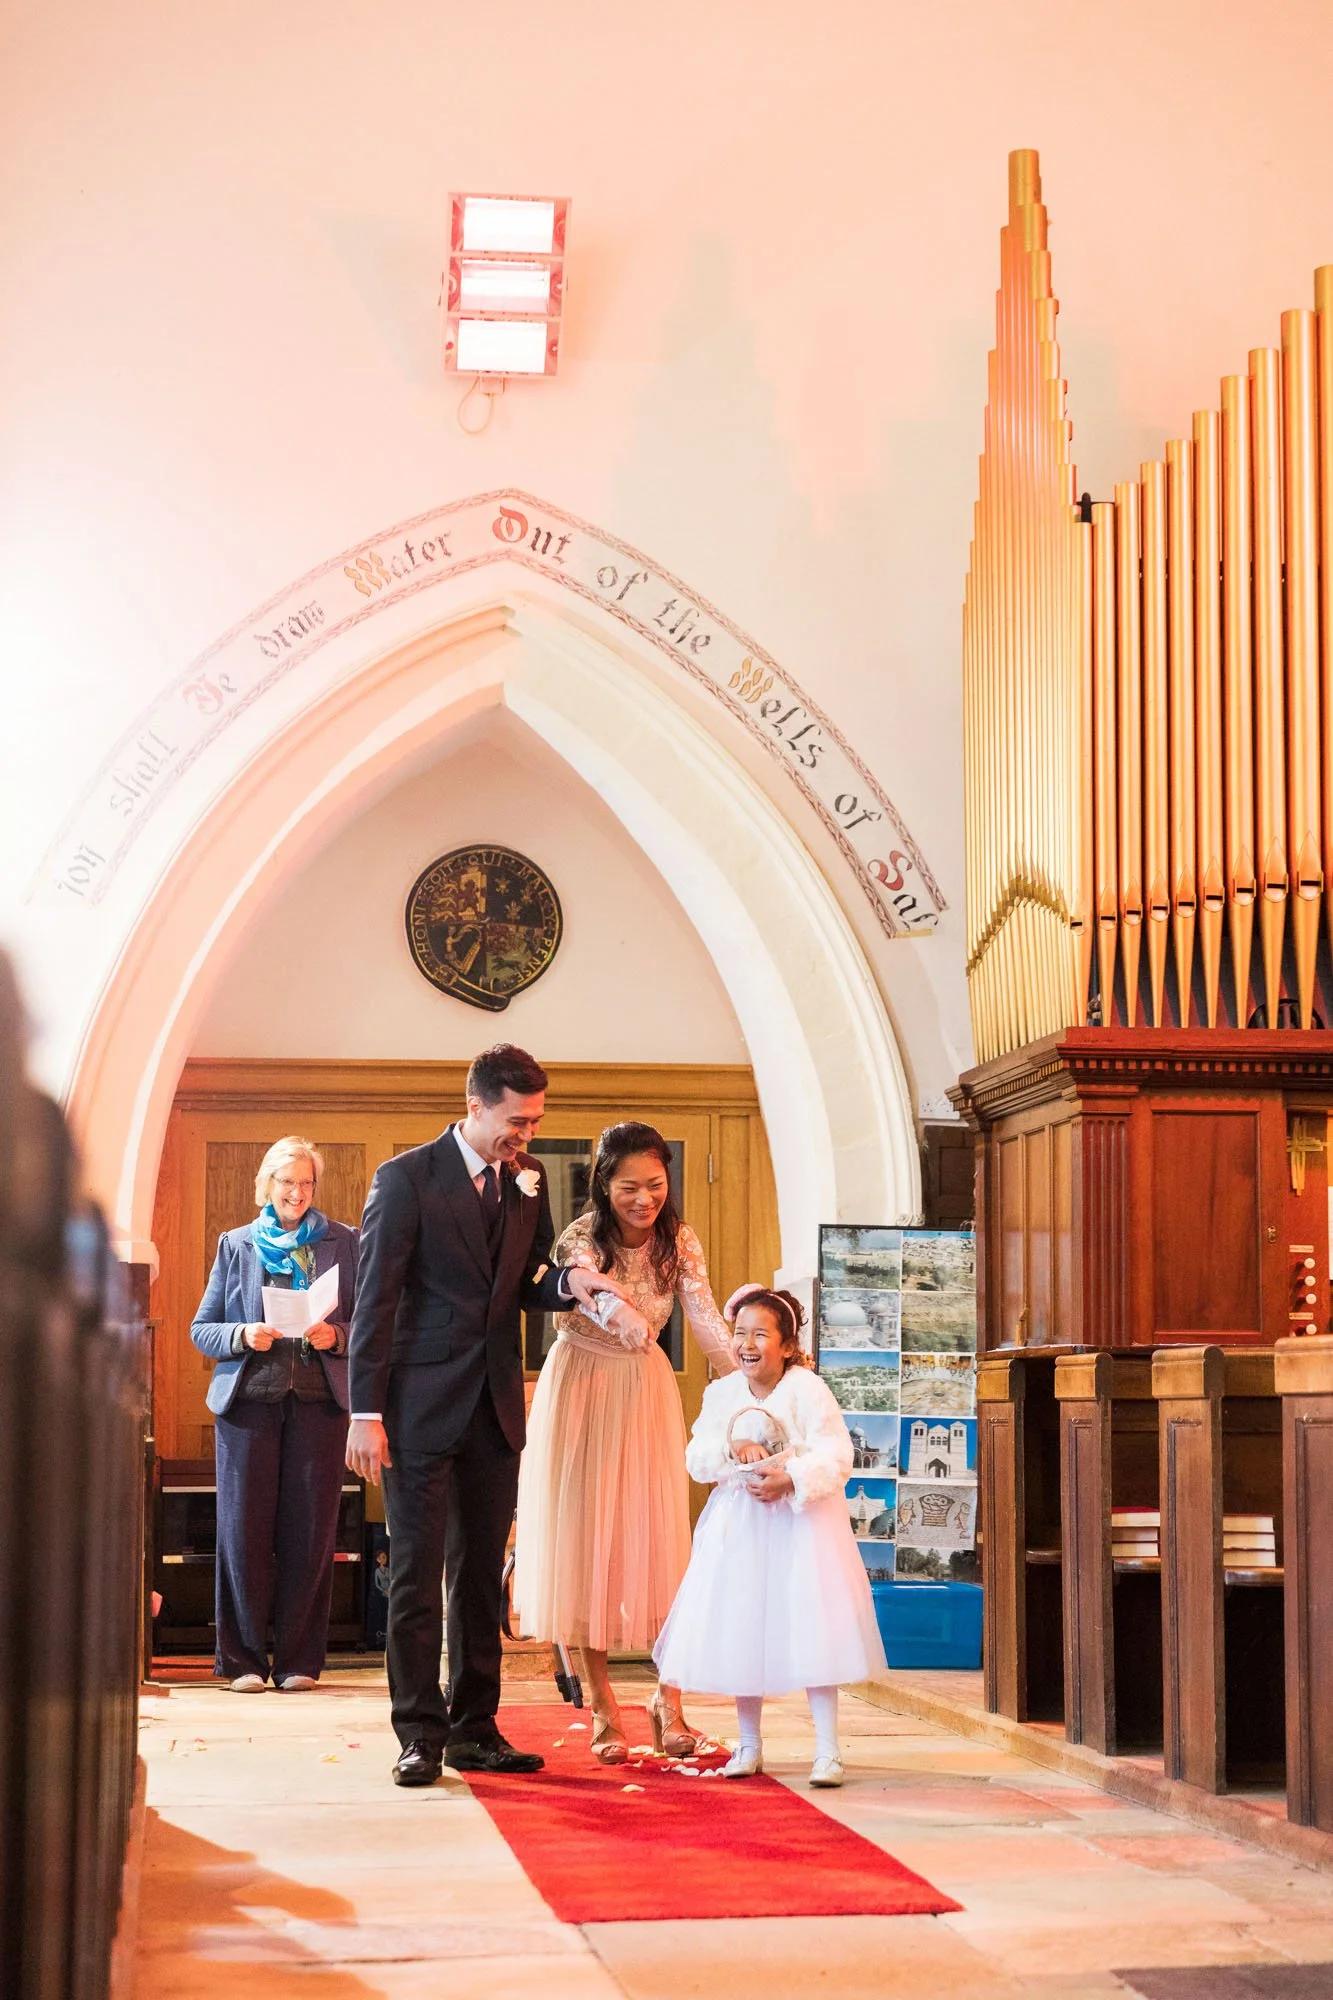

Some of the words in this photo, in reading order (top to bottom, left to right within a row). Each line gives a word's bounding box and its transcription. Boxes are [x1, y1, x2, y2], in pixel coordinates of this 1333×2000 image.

[343, 531, 452, 596] Water
[492, 506, 571, 564] Out
[597, 565, 648, 601] of
[653, 598, 711, 655] the
[728, 657, 825, 769] Wells
[834, 794, 882, 830] of
[423, 863, 454, 893] SOIT
[468, 853, 503, 867] QUI
[518, 866, 549, 899] MAL
[414, 905, 431, 953] HONI
[516, 937, 553, 983] PENSE
